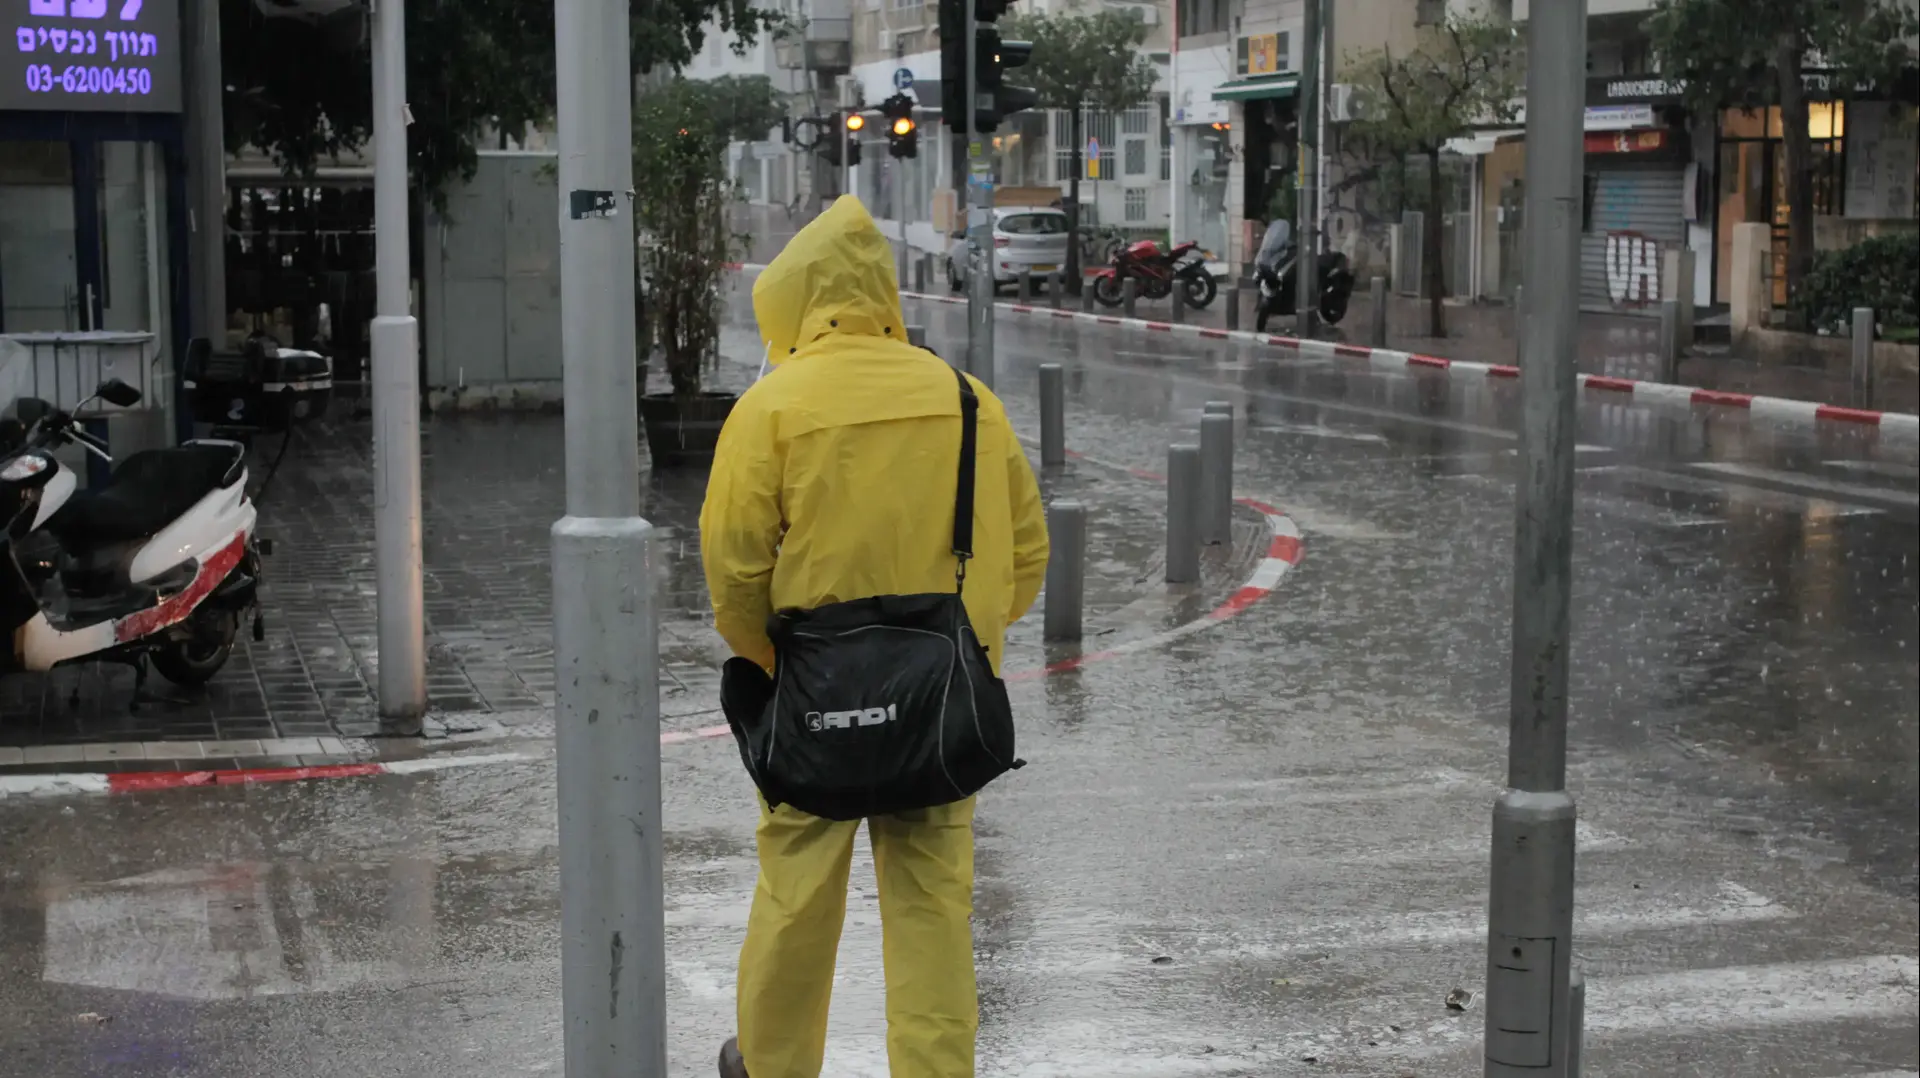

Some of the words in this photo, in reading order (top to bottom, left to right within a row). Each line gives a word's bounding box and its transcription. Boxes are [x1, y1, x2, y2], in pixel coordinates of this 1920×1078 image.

[16, 26, 97, 54] נכסים
[104, 30, 157, 62] תווך
[26, 64, 152, 94] 03-6200450
